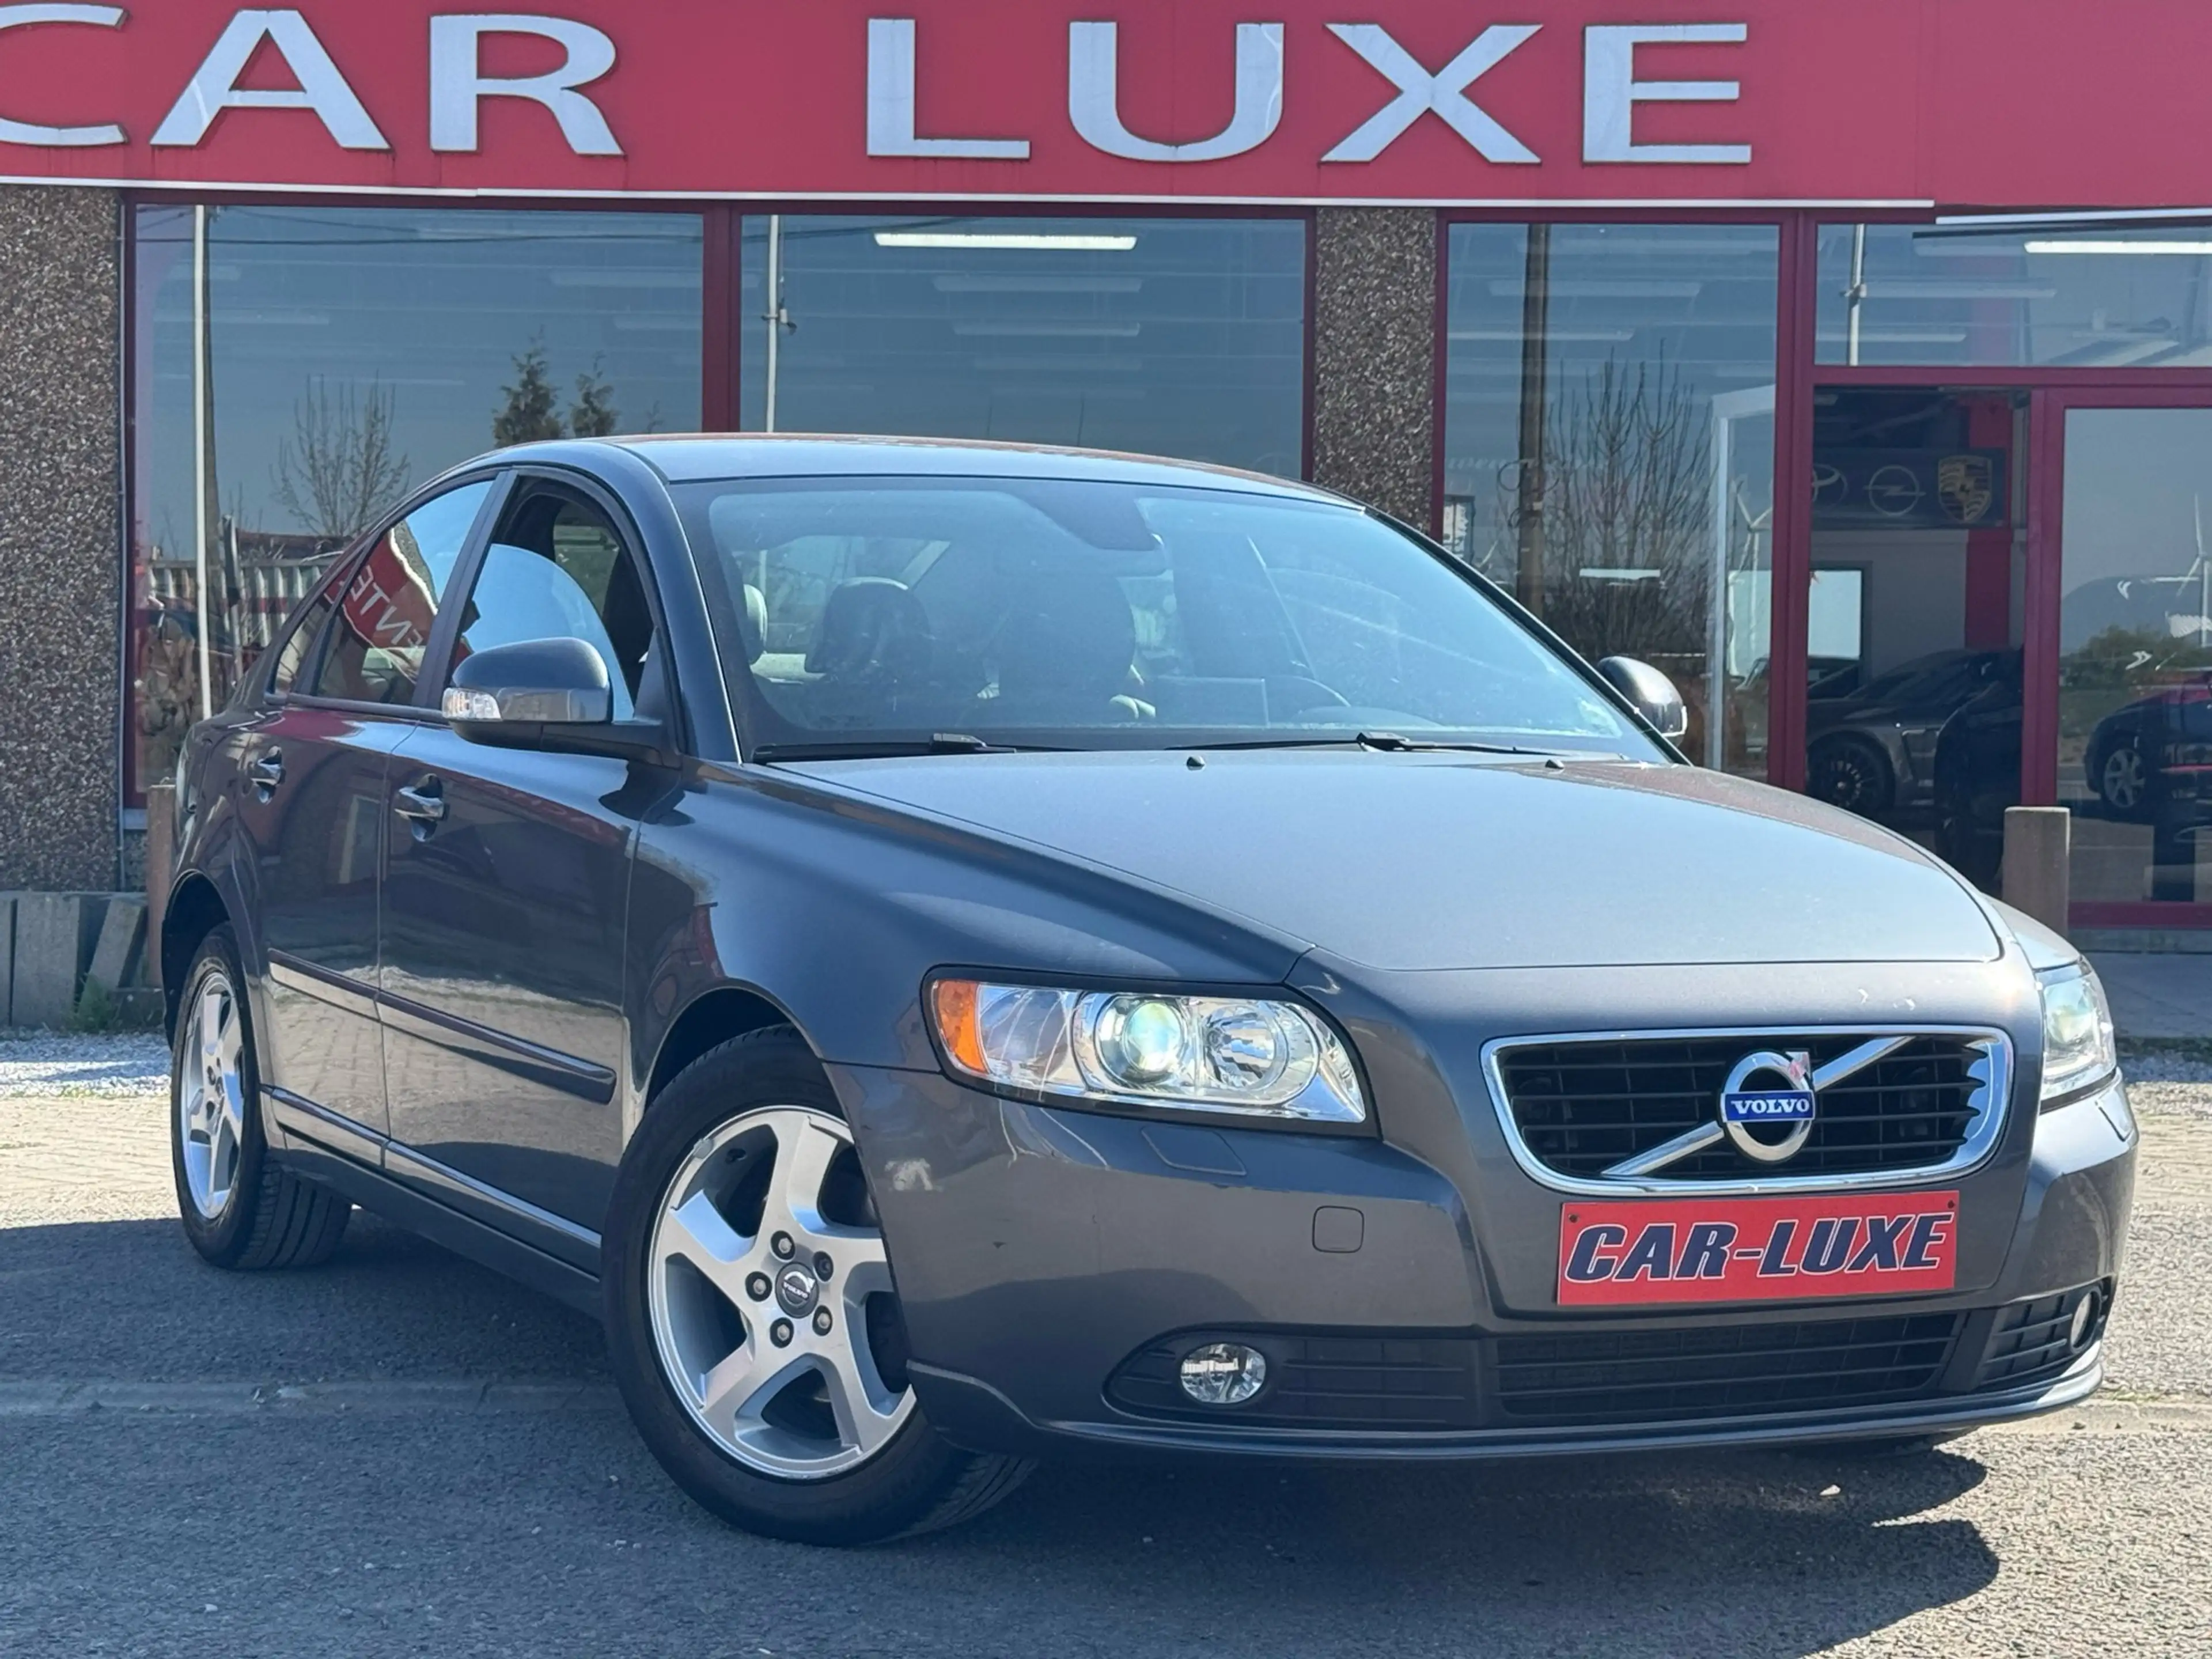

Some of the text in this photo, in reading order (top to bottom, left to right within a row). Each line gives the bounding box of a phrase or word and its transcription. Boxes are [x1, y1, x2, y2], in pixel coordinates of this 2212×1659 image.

[0, 2, 1752, 164] CAR LUXE
[1730, 1096, 1810, 1116] VOLVO
[1565, 1211, 1955, 1283] CAR-LUXE
